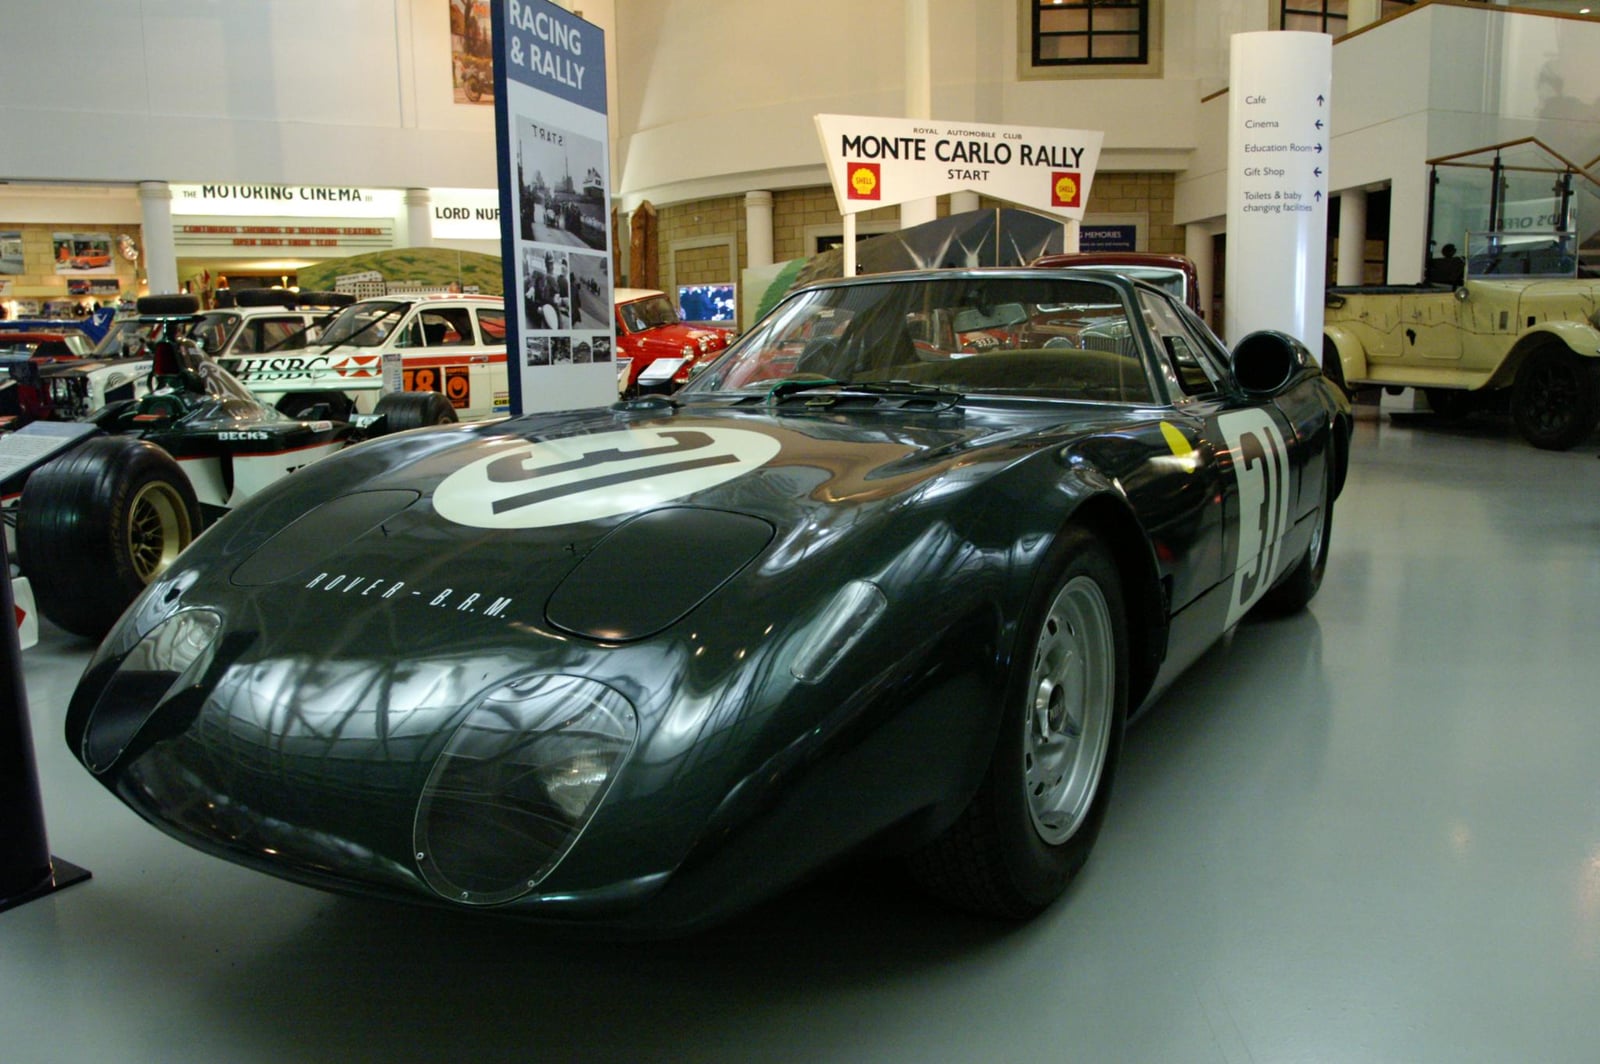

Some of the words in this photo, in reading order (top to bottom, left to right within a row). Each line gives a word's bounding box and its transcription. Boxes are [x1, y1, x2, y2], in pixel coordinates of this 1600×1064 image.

[509, 0, 582, 56] RACING
[510, 35, 525, 67] &
[530, 43, 585, 90] RALLY
[1244, 119, 1279, 129] Cinema
[913, 127, 939, 136] ROYAL
[947, 129, 996, 139] AUTOMOBILE
[1003, 132, 1023, 140] CLUB
[841, 134, 926, 161] MONTE
[934, 139, 1012, 165] CARLO
[1020, 144, 1085, 169] RALLY
[1244, 143, 1287, 153] Education
[1289, 143, 1313, 152] Room
[947, 169, 990, 182] START
[1244, 167, 1261, 176] Gift
[1263, 167, 1285, 178] Shop
[855, 176, 873, 185] SHELL
[183, 190, 197, 199] THE
[202, 185, 293, 201] MOTORING
[300, 188, 362, 202] CINEMA
[1244, 191, 1272, 200] Toilets
[1274, 190, 1281, 200] &
[1283, 190, 1302, 201] baby
[435, 207, 471, 220] LORD
[1243, 203, 1281, 214] changing
[1282, 203, 1313, 213] facilities
[238, 357, 330, 381] HSBC
[218, 431, 268, 441] BECK'S
[305, 572, 405, 599] ROVER
